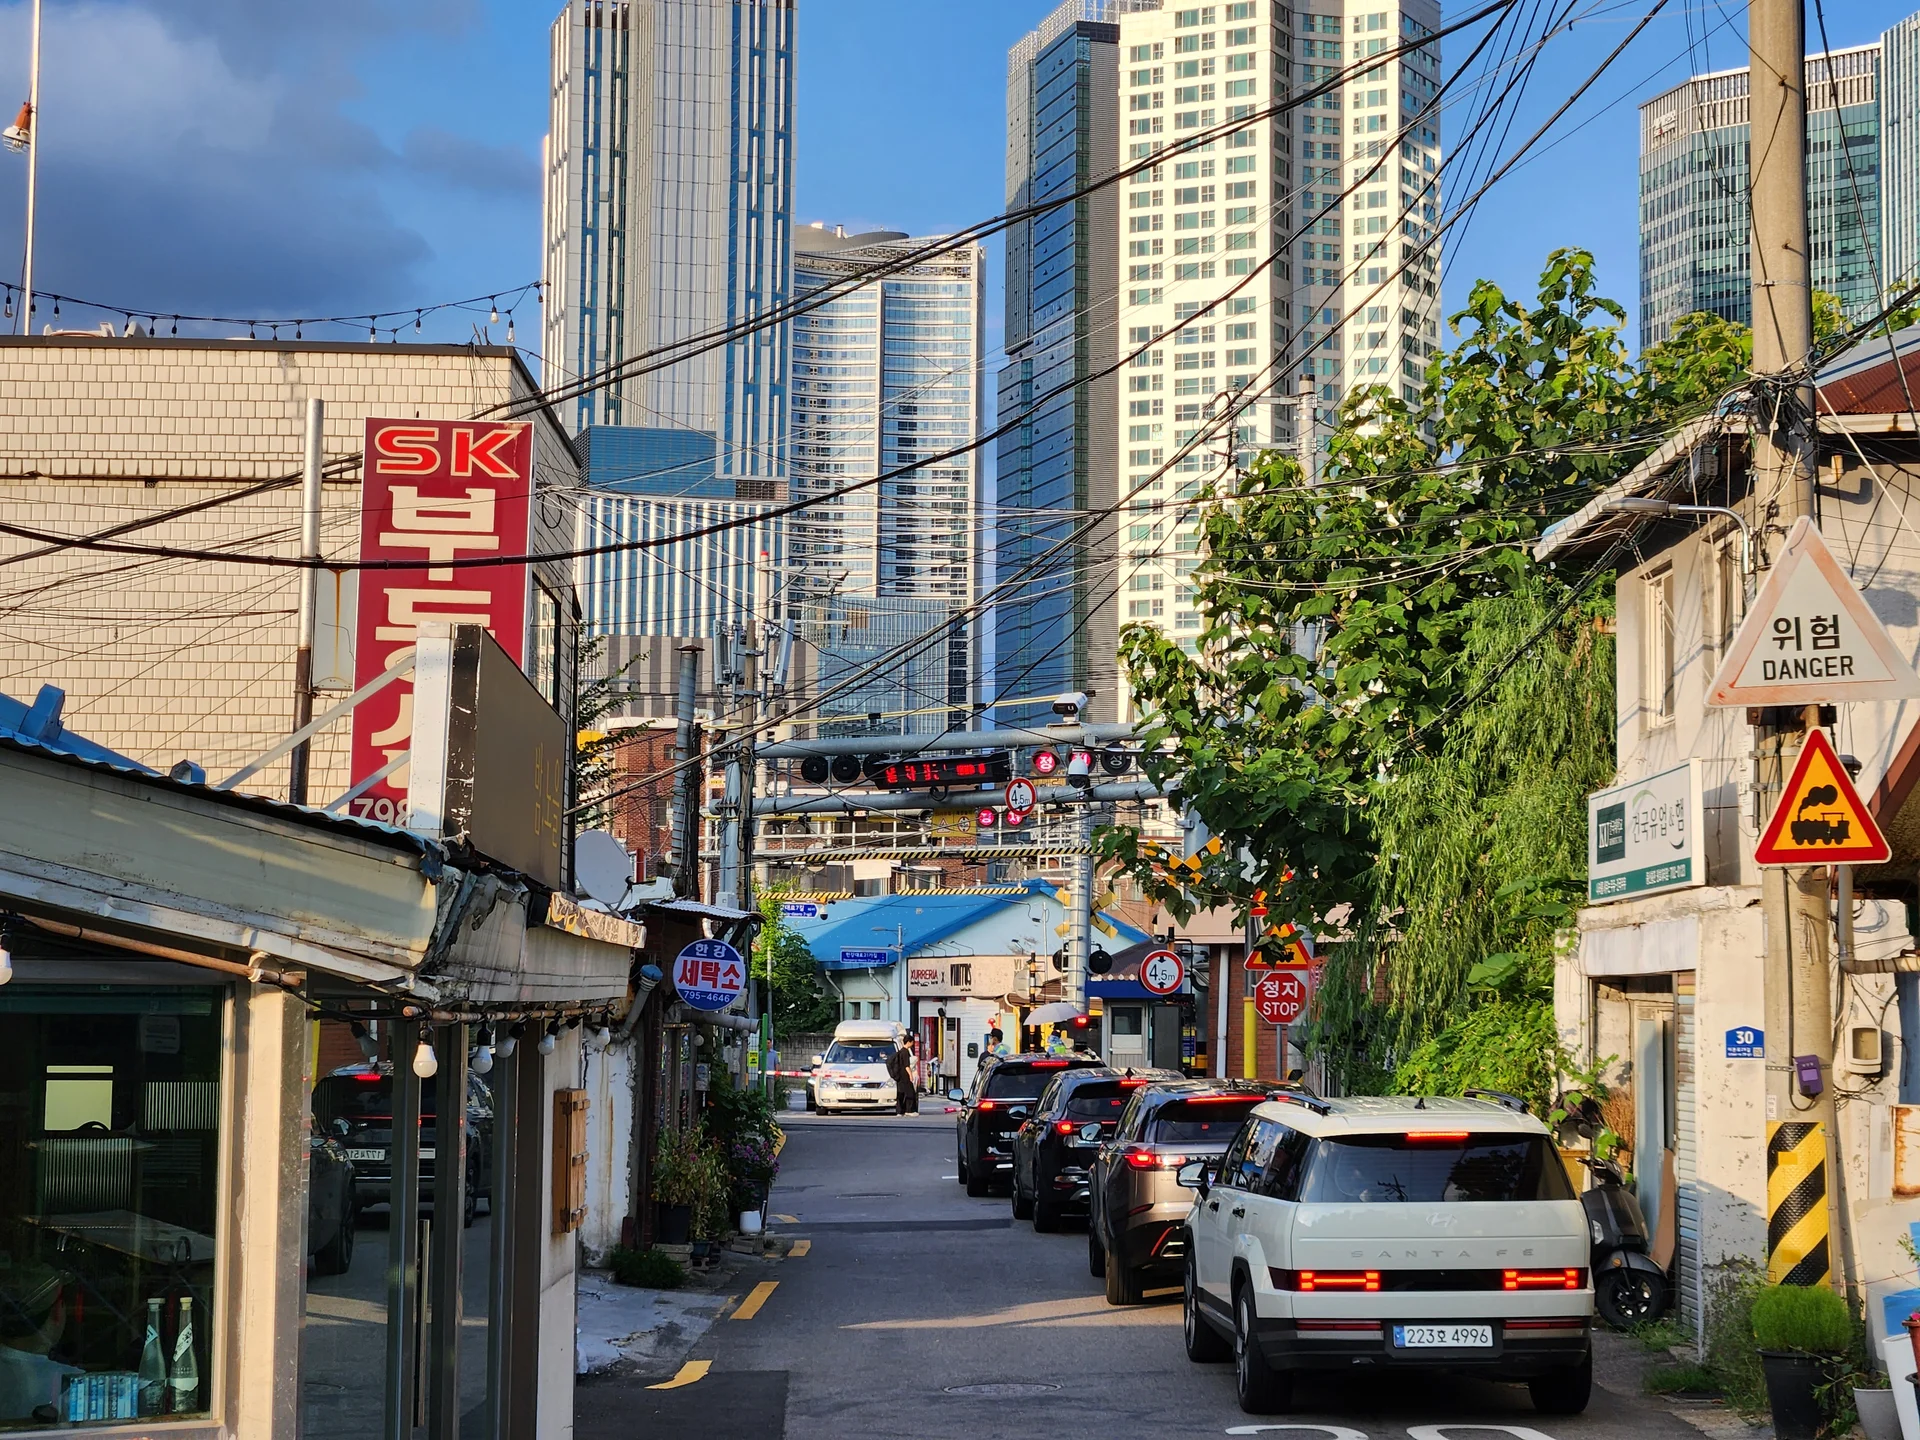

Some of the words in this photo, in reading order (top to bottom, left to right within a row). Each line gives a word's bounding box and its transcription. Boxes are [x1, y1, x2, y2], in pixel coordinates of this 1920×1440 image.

[375, 426, 522, 478] SK
[1772, 614, 1840, 651] 위험
[1763, 655, 1855, 681] DANGER
[1011, 789, 1030, 805] 4.5m
[695, 943, 726, 958] 한강
[678, 959, 740, 990] 세탁소
[1149, 963, 1176, 981] 4.5m
[684, 990, 730, 1003] 795-4646
[1262, 980, 1298, 999] 정지
[1262, 1001, 1299, 1016] STOP
[1735, 1030, 1754, 1045] 30
[1351, 1250, 1471, 1258] SANTA
[1496, 1248, 1534, 1257] FE
[1407, 1328, 1447, 1344] 223호
[1452, 1327, 1489, 1344] 4996
